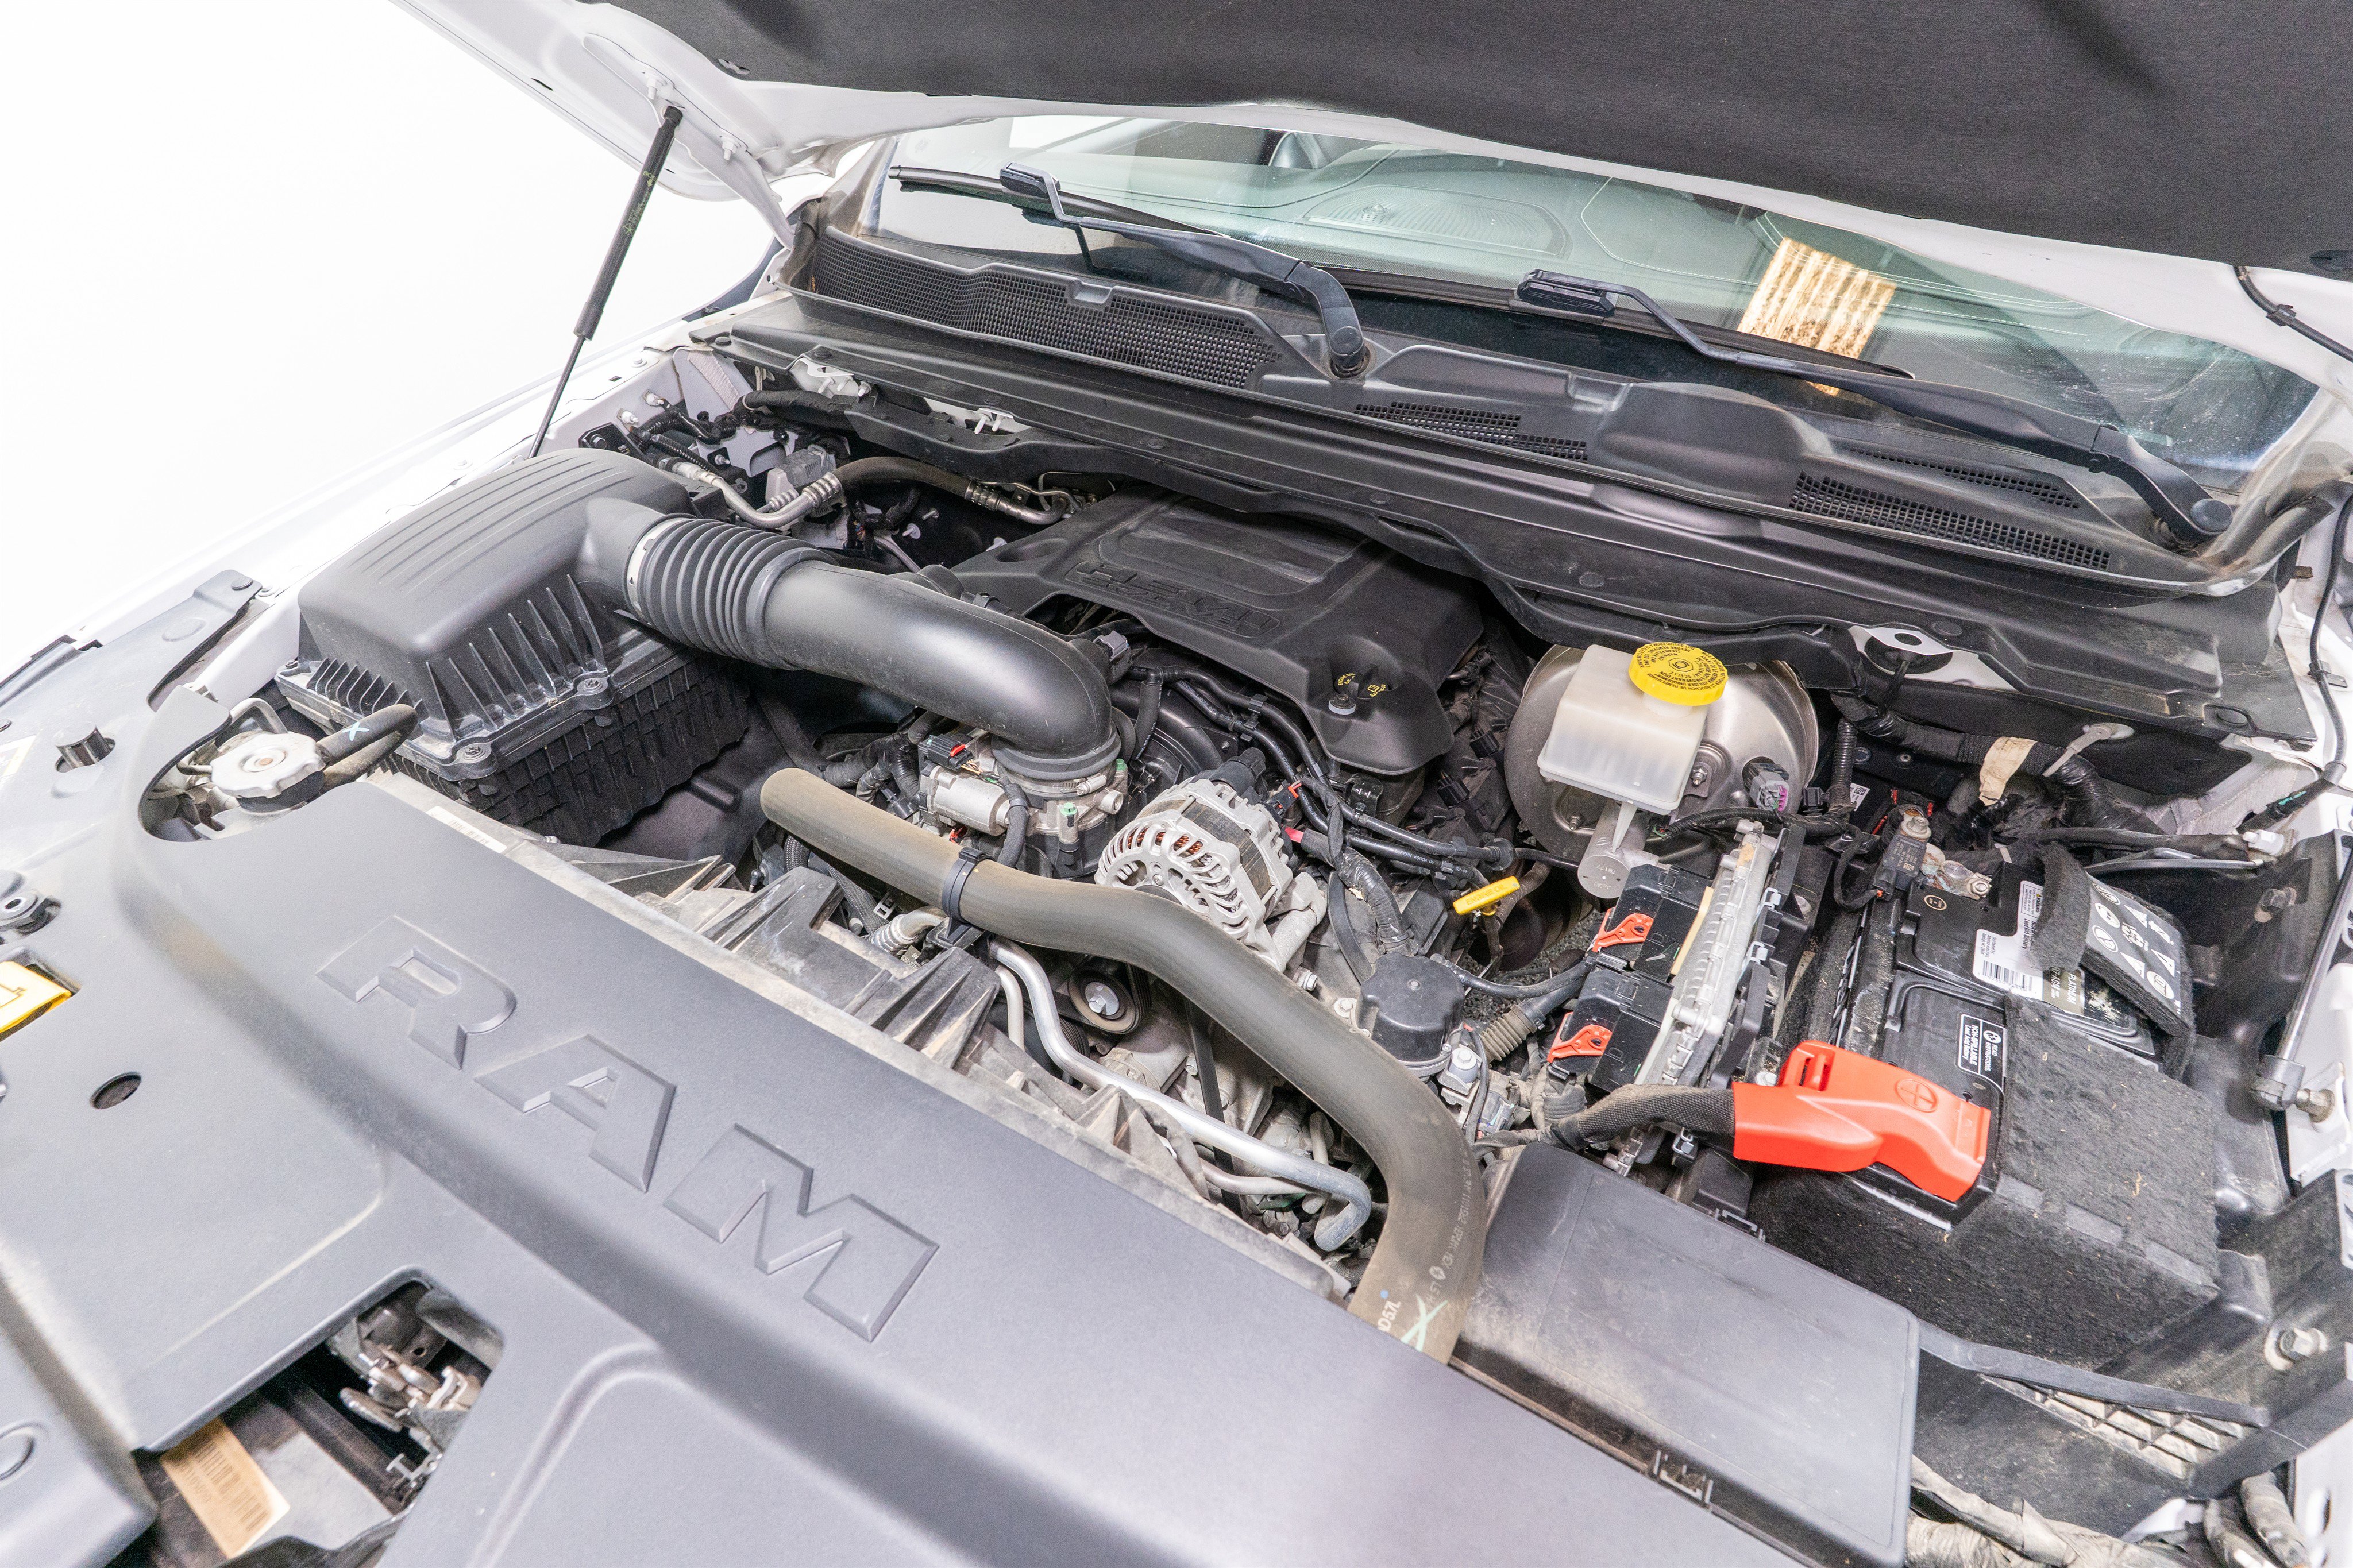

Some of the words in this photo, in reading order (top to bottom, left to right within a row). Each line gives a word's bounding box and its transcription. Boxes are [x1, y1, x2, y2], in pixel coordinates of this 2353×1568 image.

[1465, 890, 1494, 905] ENGINE
[1494, 884, 1507, 893] OIL
[2021, 935, 2029, 950] Battery
[2067, 973, 2076, 1004] PLATINUM
[1970, 1025, 1978, 1065] NON-SPILLABLE
[315, 914, 939, 1342] RAM
